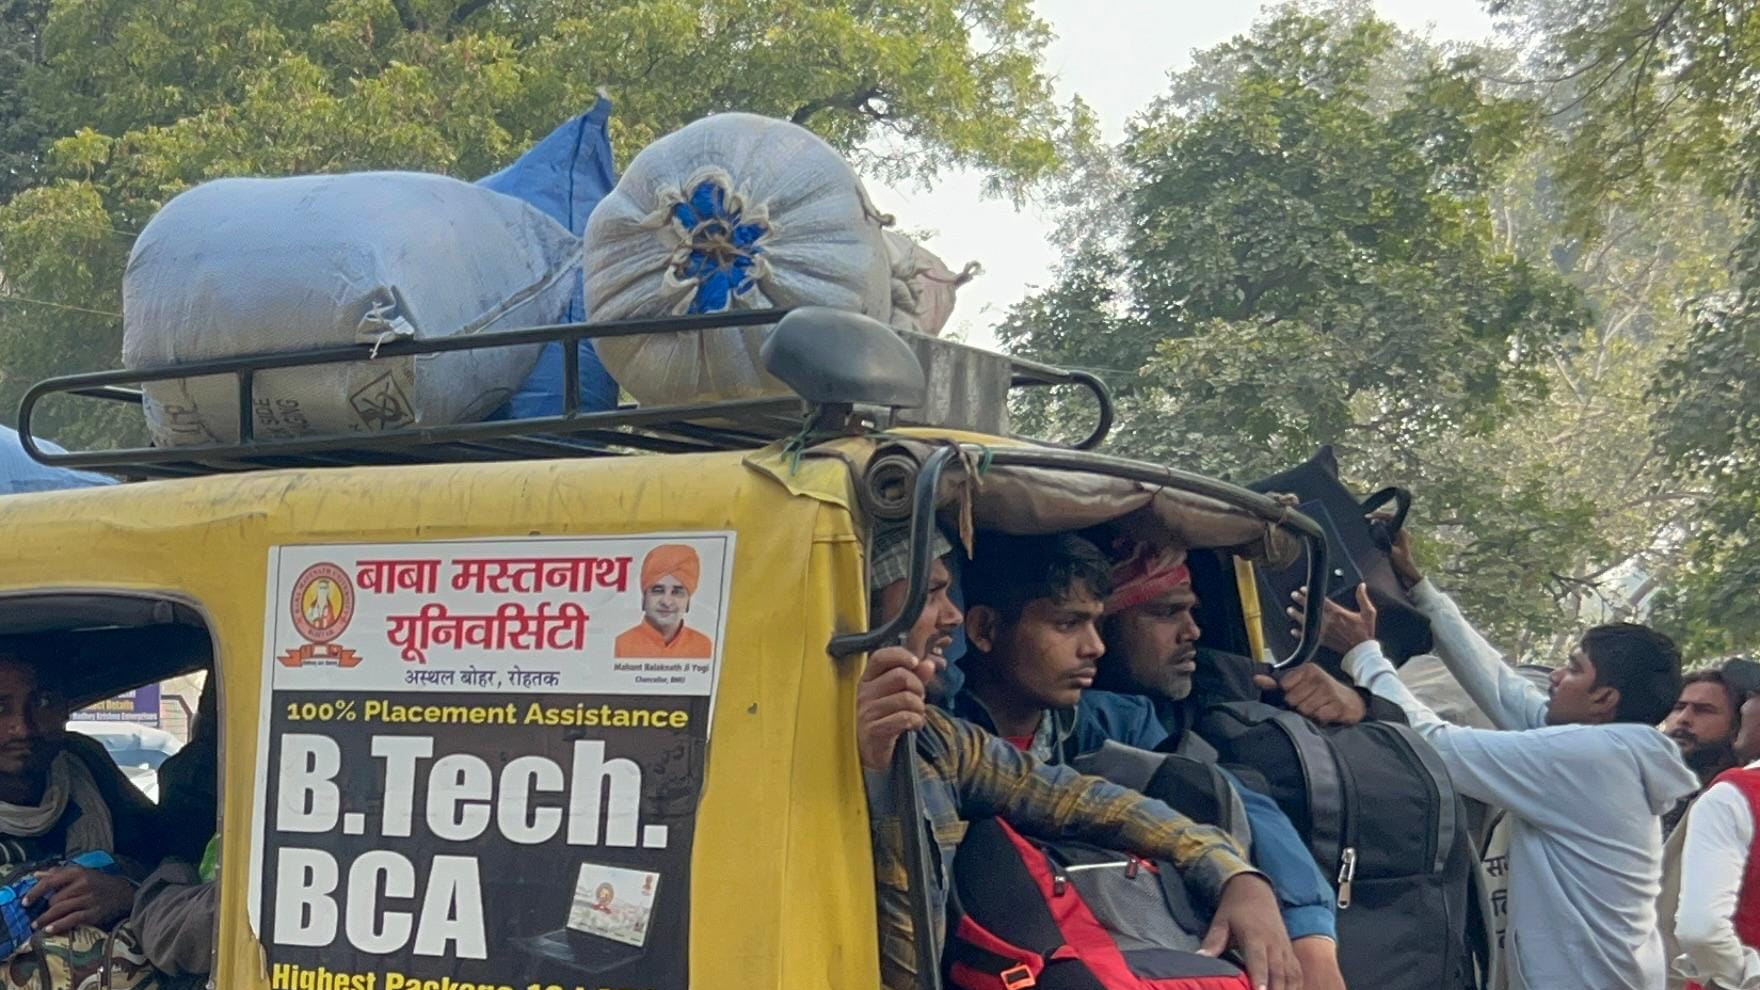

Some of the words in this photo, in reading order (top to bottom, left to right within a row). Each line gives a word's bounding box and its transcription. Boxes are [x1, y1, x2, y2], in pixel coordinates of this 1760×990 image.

[355, 559, 442, 594] बाबा
[451, 557, 633, 593] मस्तनाथ
[386, 602, 590, 664] यूनिवर्सिटी
[404, 669, 455, 687] अस्थल
[507, 664, 561, 687] रोहतक
[287, 699, 357, 722] 100%
[364, 700, 517, 726] Placement
[523, 704, 690, 729] Assistance
[276, 732, 669, 849] B.Tech.
[273, 847, 488, 960] BCA
